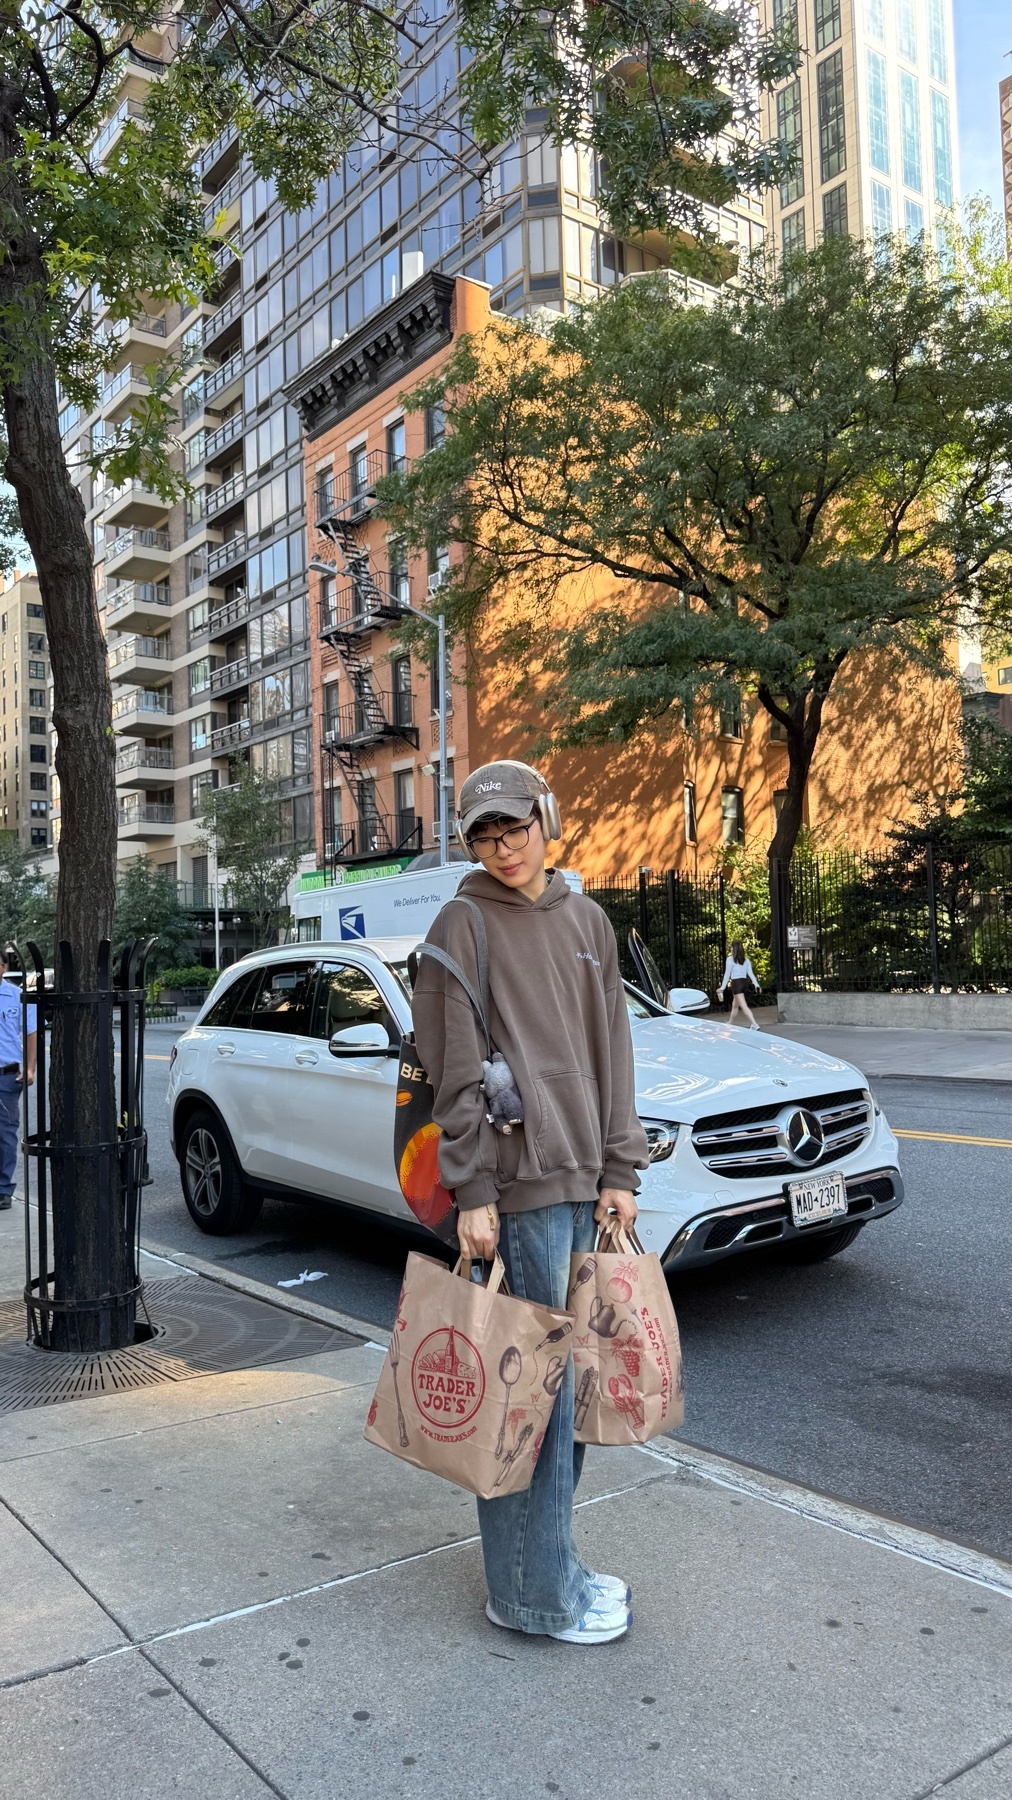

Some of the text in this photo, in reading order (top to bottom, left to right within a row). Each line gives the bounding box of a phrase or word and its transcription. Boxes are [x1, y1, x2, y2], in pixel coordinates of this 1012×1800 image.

[475, 781, 502, 794] Nike
[394, 894, 441, 907] We Deliver For You.
[804, 1183, 816, 1191] NEW
[641, 1307, 669, 1421] TRADER JOE'S
[418, 1374, 476, 1397] TRADER
[423, 1393, 466, 1414] JOE'S
